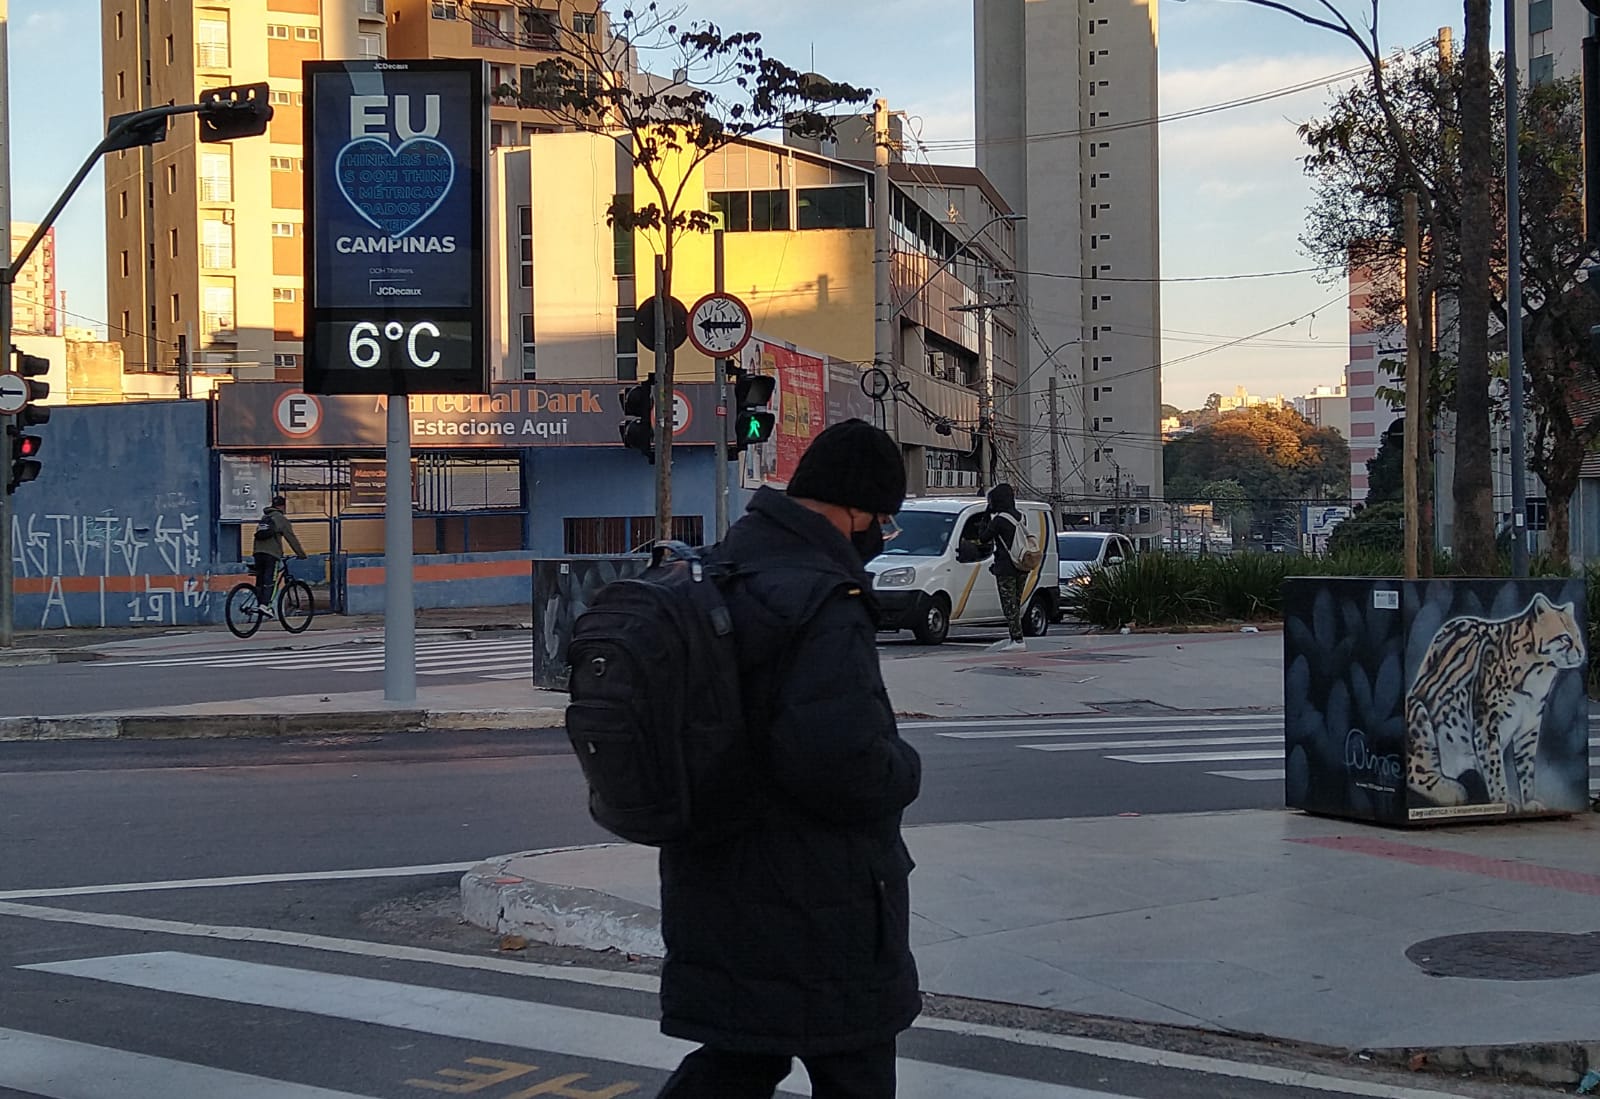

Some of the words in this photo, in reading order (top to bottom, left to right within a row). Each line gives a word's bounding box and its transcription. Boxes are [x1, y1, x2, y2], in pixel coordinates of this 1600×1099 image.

[350, 95, 441, 141] EU
[336, 236, 456, 253] CAMPINAS
[376, 286, 422, 296] JCDecaux
[349, 321, 441, 368] 6°C
[289, 398, 308, 428] E
[375, 389, 520, 414] arechal
[527, 389, 603, 414] Park
[412, 418, 515, 436] Estacione
[520, 418, 568, 438] Aqui
